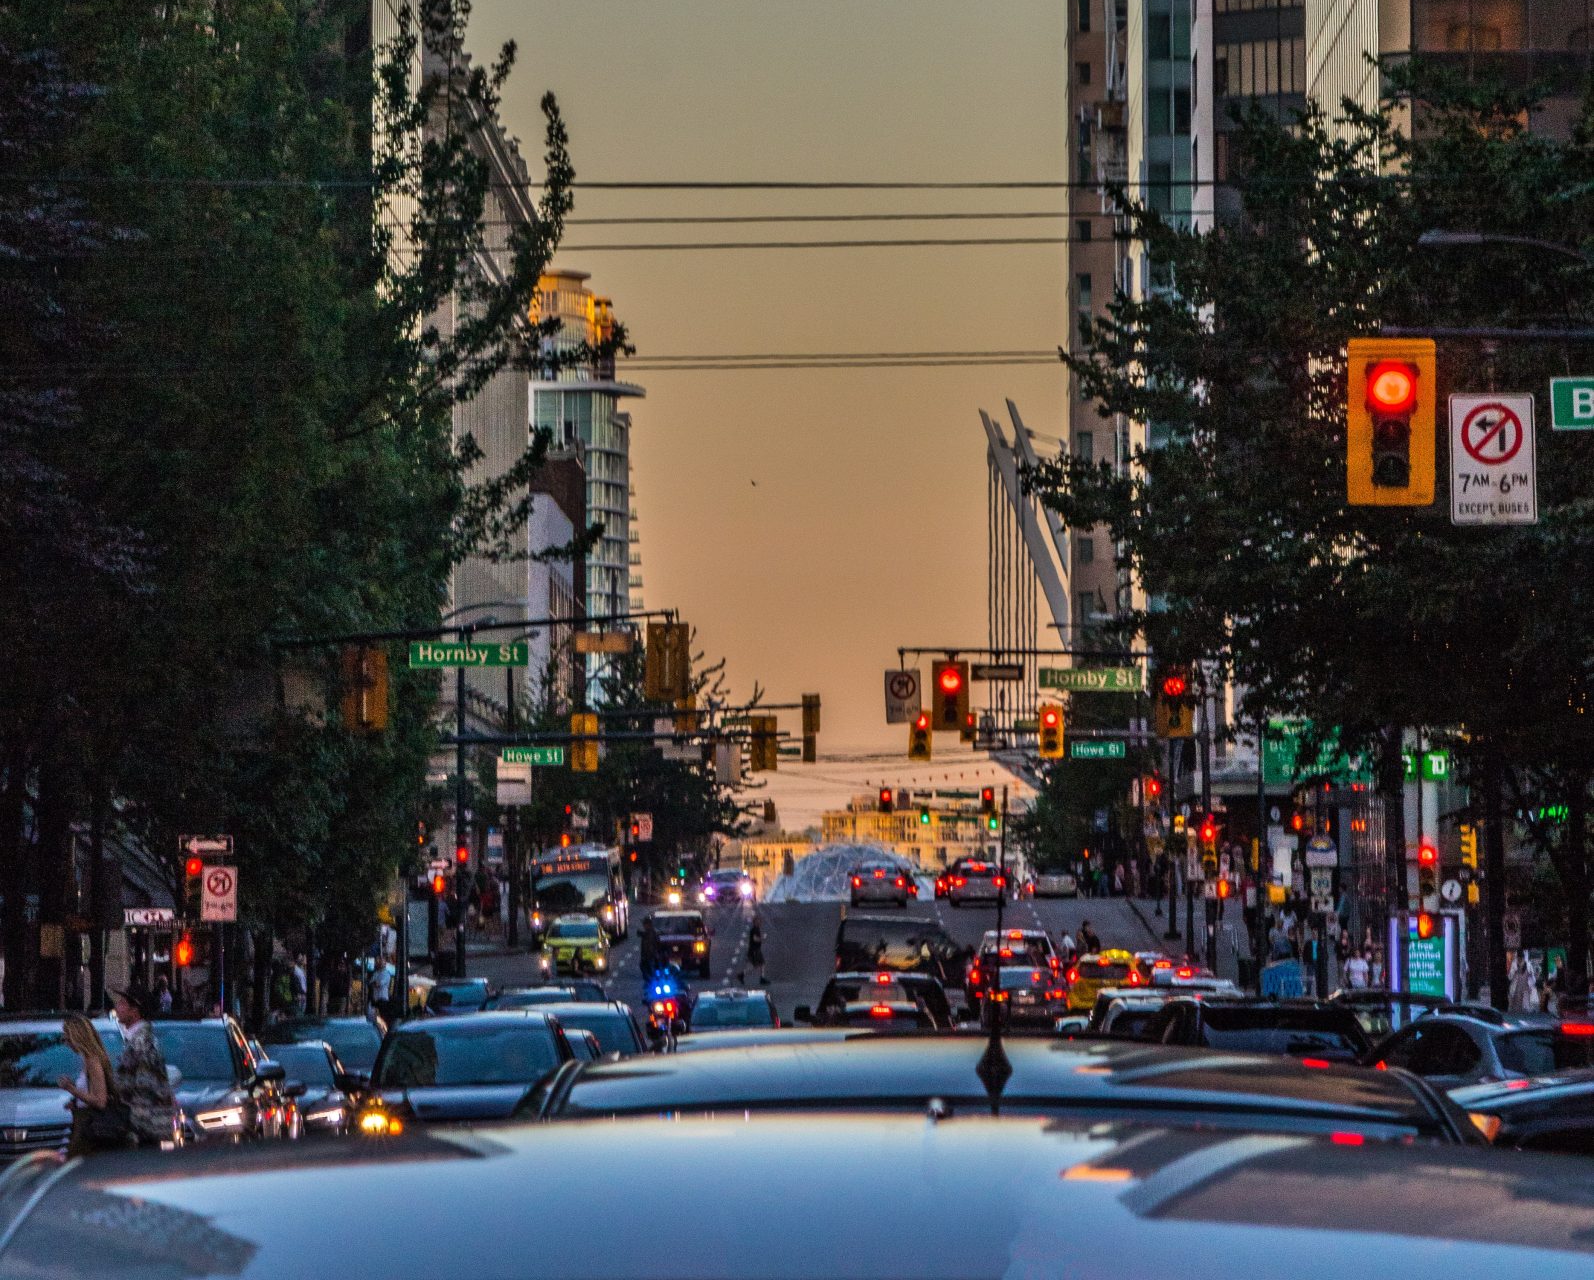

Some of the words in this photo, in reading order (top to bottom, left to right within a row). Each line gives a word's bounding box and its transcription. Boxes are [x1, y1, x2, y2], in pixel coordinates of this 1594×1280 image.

[1573, 388, 1594, 418] B
[1458, 502, 1494, 515] EXCEPT
[1499, 502, 1530, 515] BUSES
[419, 644, 488, 666] Hornby
[499, 645, 519, 662] St
[1047, 670, 1107, 688] Hornby
[1116, 668, 1133, 686] St
[507, 749, 541, 763] Howe
[547, 749, 558, 763] St
[1075, 743, 1104, 756] Howe
[1108, 742, 1120, 755] St
